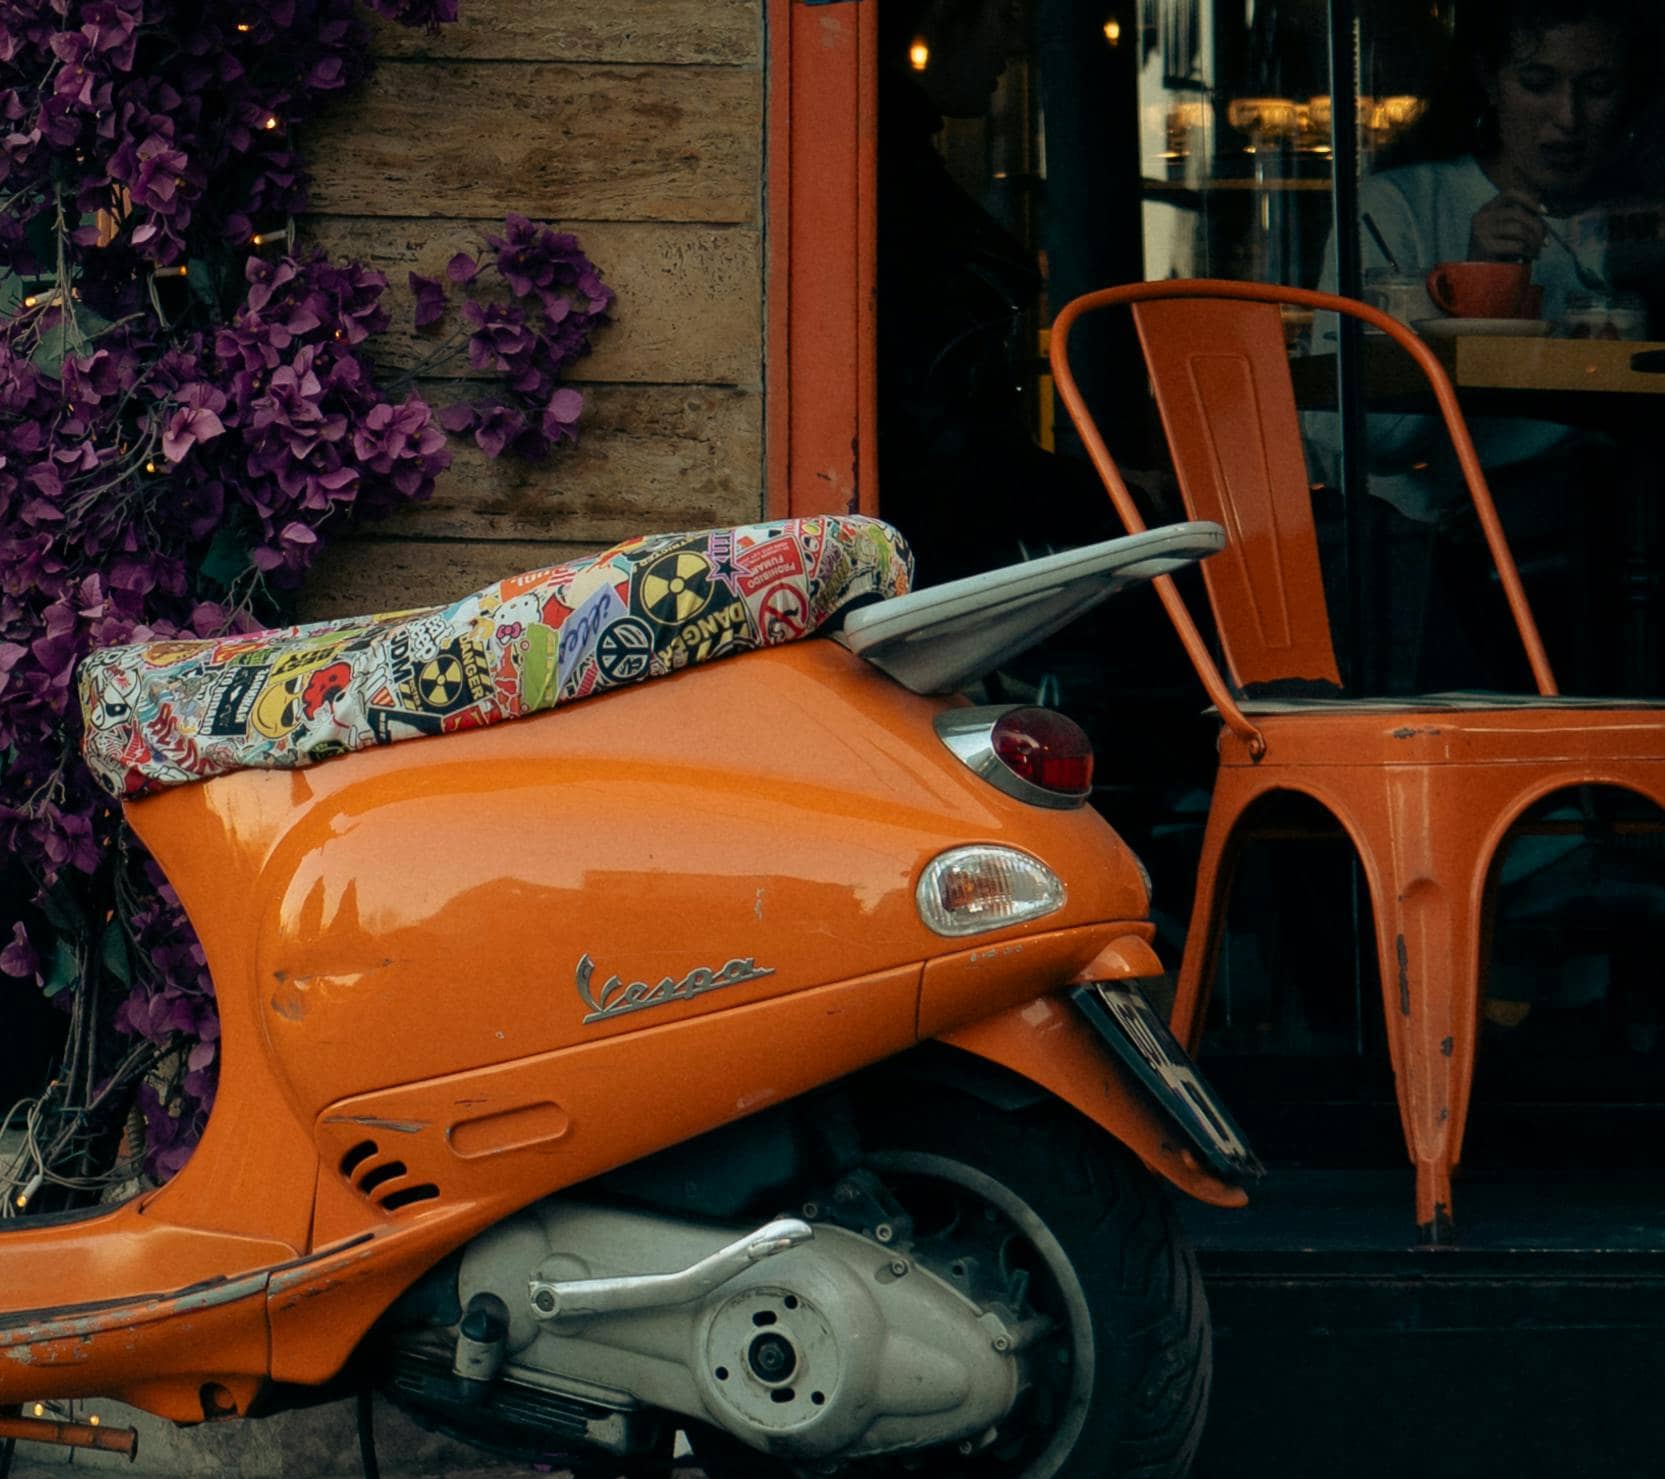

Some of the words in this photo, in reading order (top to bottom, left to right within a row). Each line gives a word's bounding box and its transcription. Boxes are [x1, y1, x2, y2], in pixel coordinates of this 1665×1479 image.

[748, 563, 796, 588] PROHIBIDO
[459, 634, 485, 700] DANGER
[575, 952, 776, 1025] Vespa
